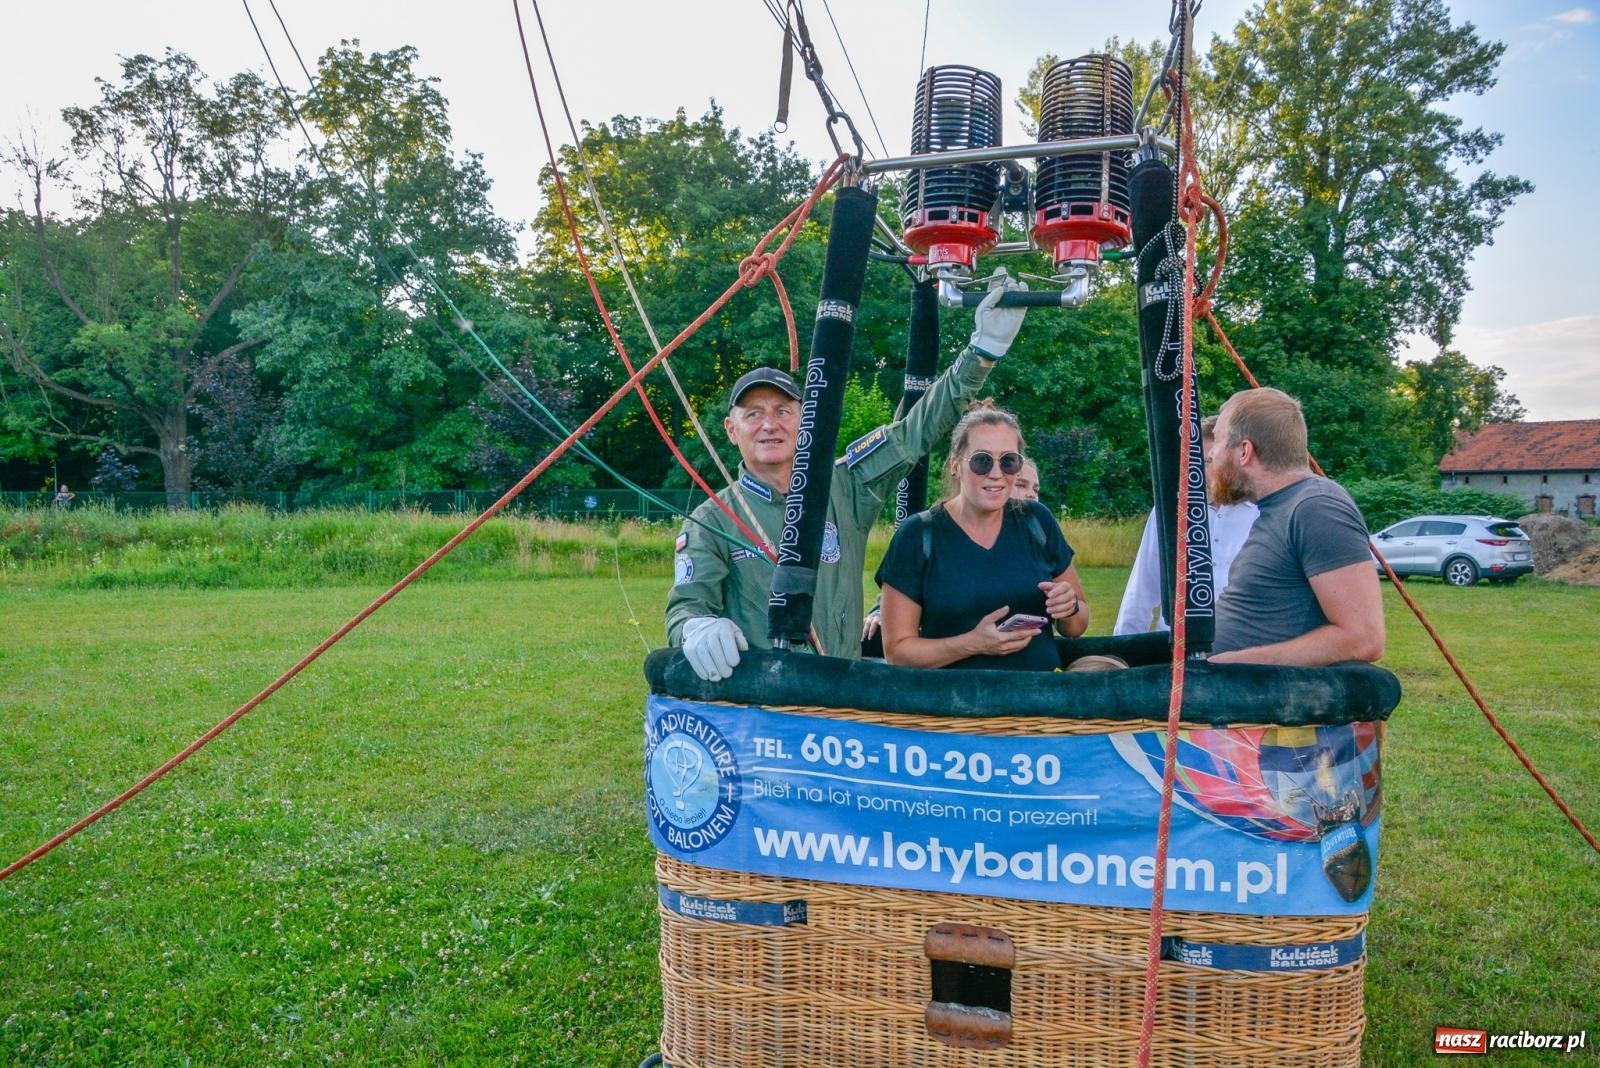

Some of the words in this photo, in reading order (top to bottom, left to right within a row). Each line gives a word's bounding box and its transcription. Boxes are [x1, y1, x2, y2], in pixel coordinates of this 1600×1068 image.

[768, 357, 827, 606] lybalonem.pl
[661, 713, 736, 778] ADVENTURE
[753, 737, 793, 760] TEL.
[801, 733, 1061, 786] 603-10-20-30
[647, 787, 666, 828] LOTY
[668, 804, 735, 849] BALONEM
[754, 779, 791, 799] Bilet
[797, 787, 823, 803] na
[829, 787, 851, 806] lot
[974, 807, 1001, 823] na
[1009, 808, 1098, 828] prezent!
[753, 827, 1288, 903] www.lotybalonem.pl
[680, 906, 737, 921] BALLOONS
[1270, 956, 1339, 968] BALLOONS
